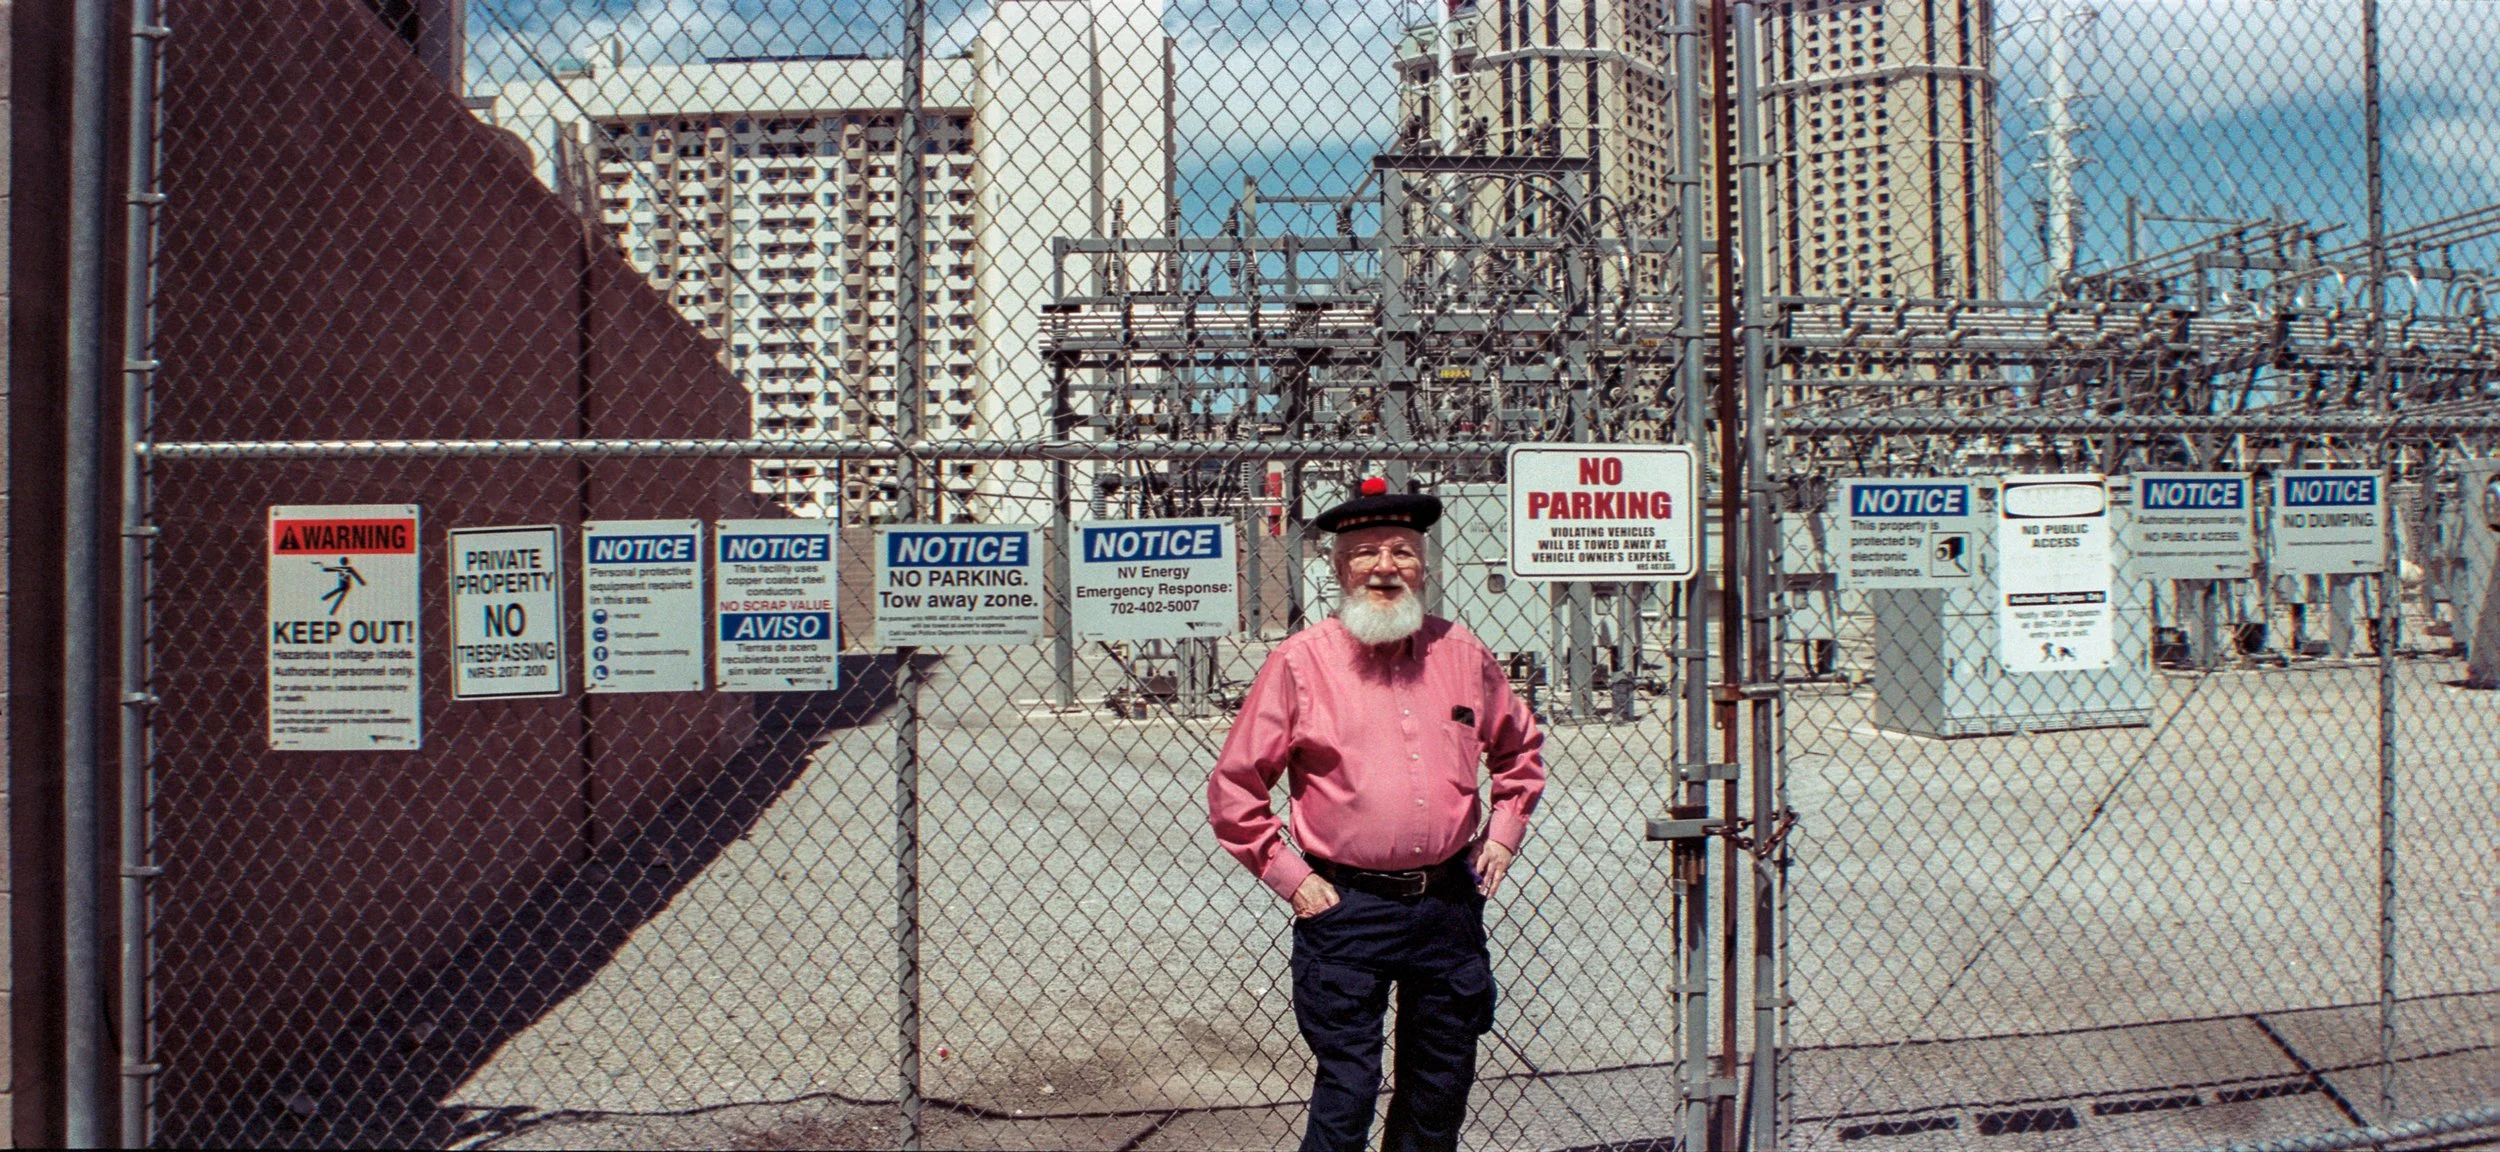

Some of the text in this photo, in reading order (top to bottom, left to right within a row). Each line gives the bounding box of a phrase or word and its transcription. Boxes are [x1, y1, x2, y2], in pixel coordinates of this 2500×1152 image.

[1579, 457, 1623, 486] NO
[2150, 483, 2238, 506] NOTICE
[2291, 480, 2370, 502] NOTICE
[1528, 491, 1672, 520] PARKING
[1858, 489, 1962, 513] NOTICE
[1851, 520, 1939, 533] This property is
[2283, 513, 2377, 528] NO DUMPING.
[1551, 527, 1655, 537] VIOLATING VEHICLES
[2022, 524, 2089, 535] NO PUBLIC
[302, 525, 407, 550] WARNING
[1092, 529, 1214, 559] NOTICE
[1851, 535, 1922, 549] protected by
[2032, 537, 2081, 548] ACCESS
[2144, 532, 2160, 542] NO
[2161, 532, 2198, 542] PUBLIC
[596, 538, 691, 560] NOTICE
[728, 537, 825, 559] NOTICE
[897, 536, 1021, 563] NOTICE
[1538, 539, 1667, 550] WILL BE TOWED AWAY AT
[466, 548, 541, 571] PRIVATE
[1532, 551, 1674, 563] VEHICLE OWNER'S EXPENSE.
[1851, 551, 1907, 562] electronic
[589, 566, 692, 578] Personal protective
[733, 563, 819, 576] This facility uses
[1118, 565, 1190, 581] NV Energy
[1851, 566, 1923, 578] surveillance.
[456, 572, 555, 596] PROPERTY
[726, 575, 826, 587] copper coated steel
[889, 568, 1028, 587] NO PARKING.
[589, 580, 693, 594] equipment required
[746, 586, 806, 597] conductors.
[1076, 582, 1233, 600] Emergency Response:
[590, 595, 652, 605] in this area.
[720, 599, 834, 611] NO SCRAP VALUE.
[879, 592, 1039, 613] Tow away zone.
[1110, 600, 1199, 615] 702-402-5007
[484, 602, 526, 637] NO
[734, 615, 820, 638] AVISO
[273, 620, 414, 644] KEEP OUT!
[457, 642, 556, 664] TRESPASSING
[736, 642, 818, 653] Tierras de acero
[273, 649, 415, 662] Hazardous voltage inside.
[721, 653, 832, 664] recubiertas con cobre
[273, 666, 415, 678] Authorized personnel only.
[728, 665, 827, 676] sin valor comercial.
